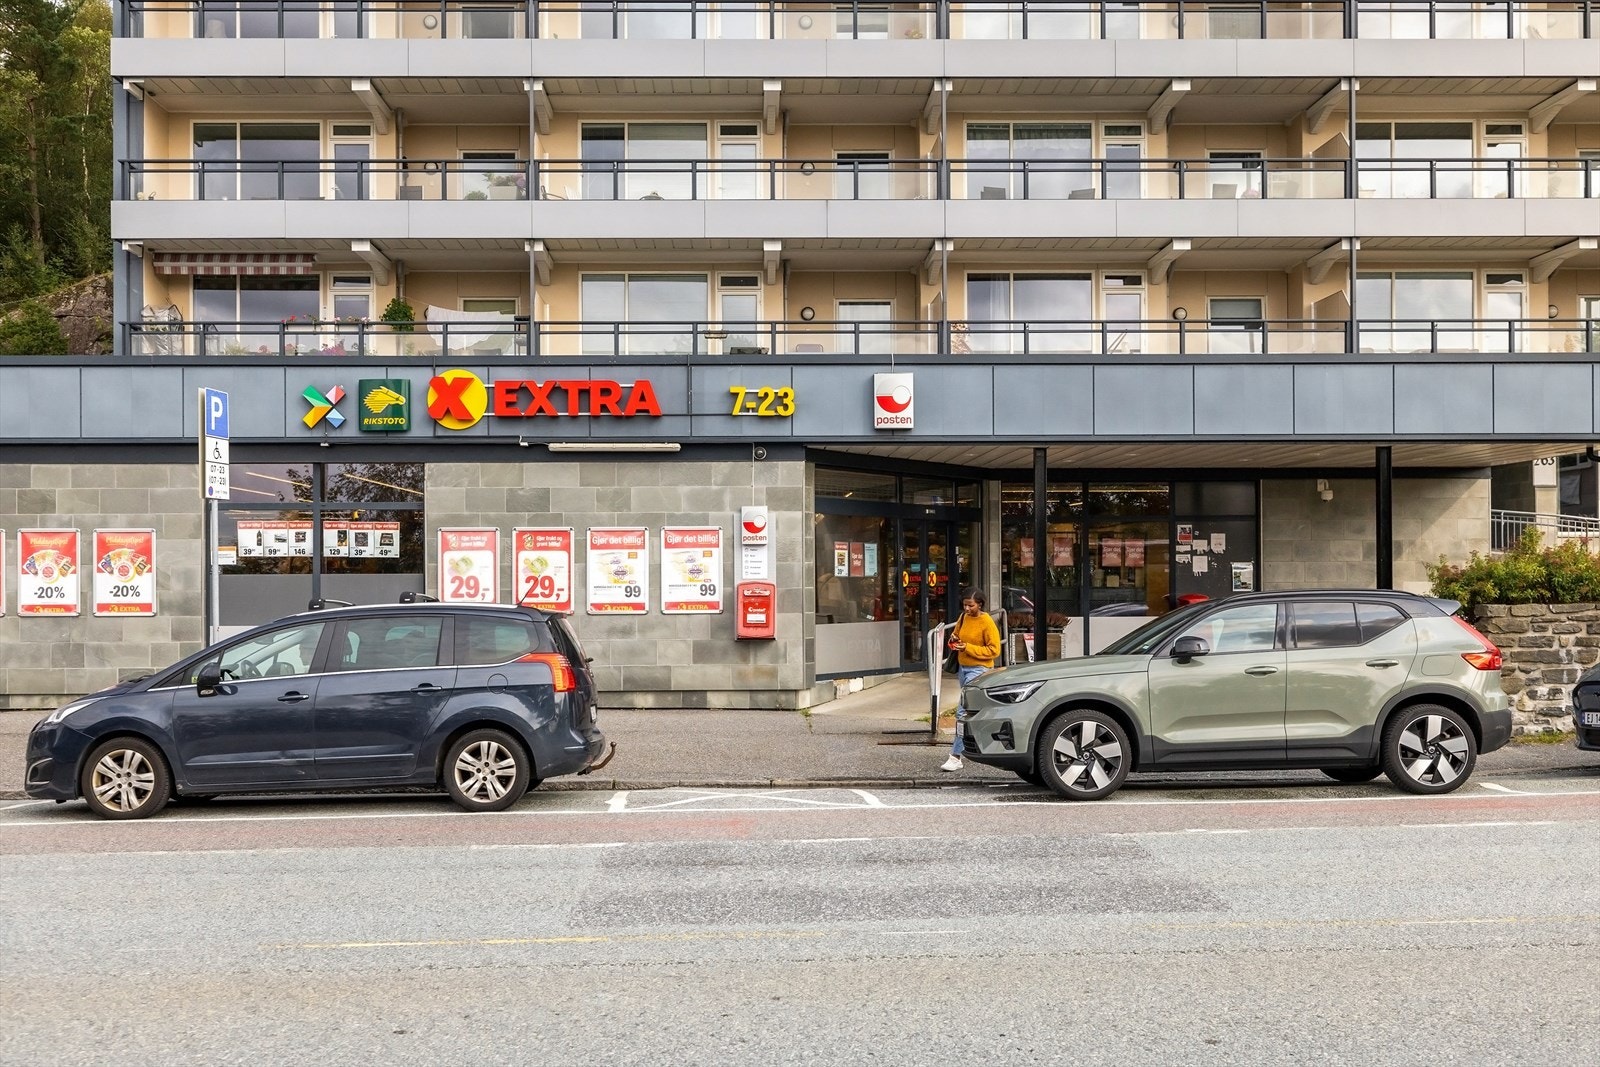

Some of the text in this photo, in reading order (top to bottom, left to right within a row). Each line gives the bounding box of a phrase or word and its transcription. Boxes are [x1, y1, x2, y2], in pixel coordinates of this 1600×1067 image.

[494, 380, 662, 417] EXTRA
[729, 386, 795, 417] 7-23
[211, 395, 223, 431] P
[363, 418, 406, 426] RIKSTOTO
[876, 415, 912, 426] posten
[592, 535, 644, 545] Gjør det billig!
[667, 534, 718, 544] Gjør det billig!
[34, 586, 65, 598] -20%
[109, 585, 140, 597] -20%
[624, 585, 641, 598] 99
[700, 584, 716, 596] 99
